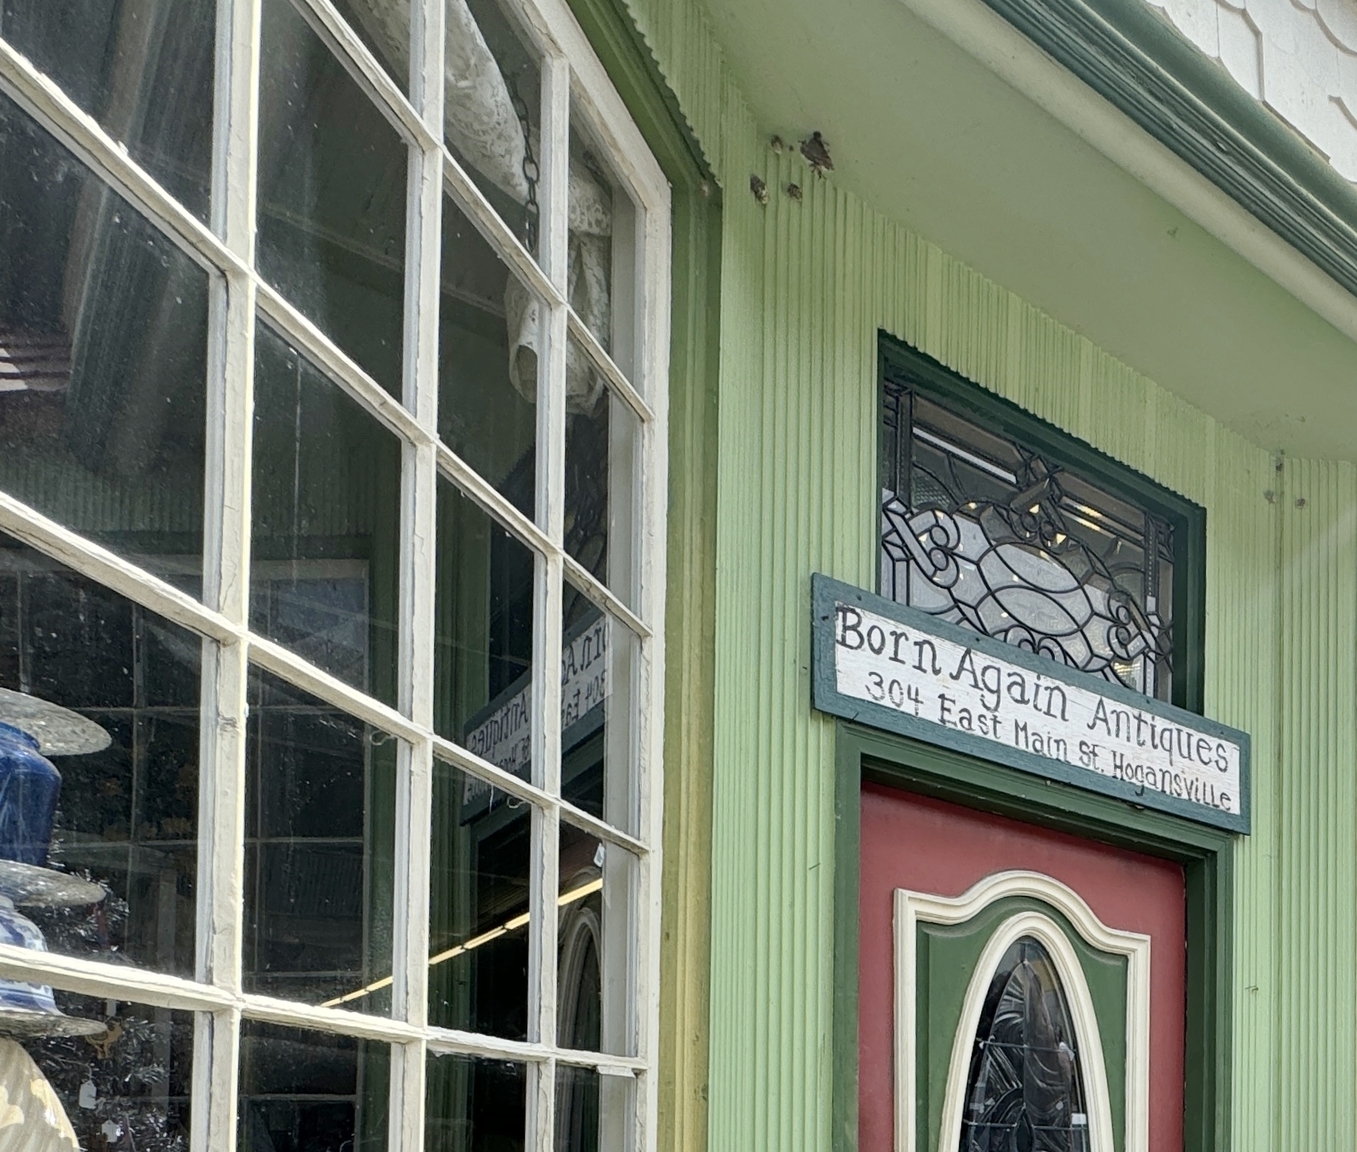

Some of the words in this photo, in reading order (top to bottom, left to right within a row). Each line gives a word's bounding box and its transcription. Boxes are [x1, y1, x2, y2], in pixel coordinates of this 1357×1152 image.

[835, 606, 942, 677] Born
[949, 646, 1070, 723] Again
[1086, 696, 1229, 773] Antiques
[865, 671, 924, 717] 304
[937, 692, 1002, 740] East
[1014, 718, 1072, 766] Main
[1078, 739, 1105, 774] St.
[1111, 749, 1232, 812] Hogansville
